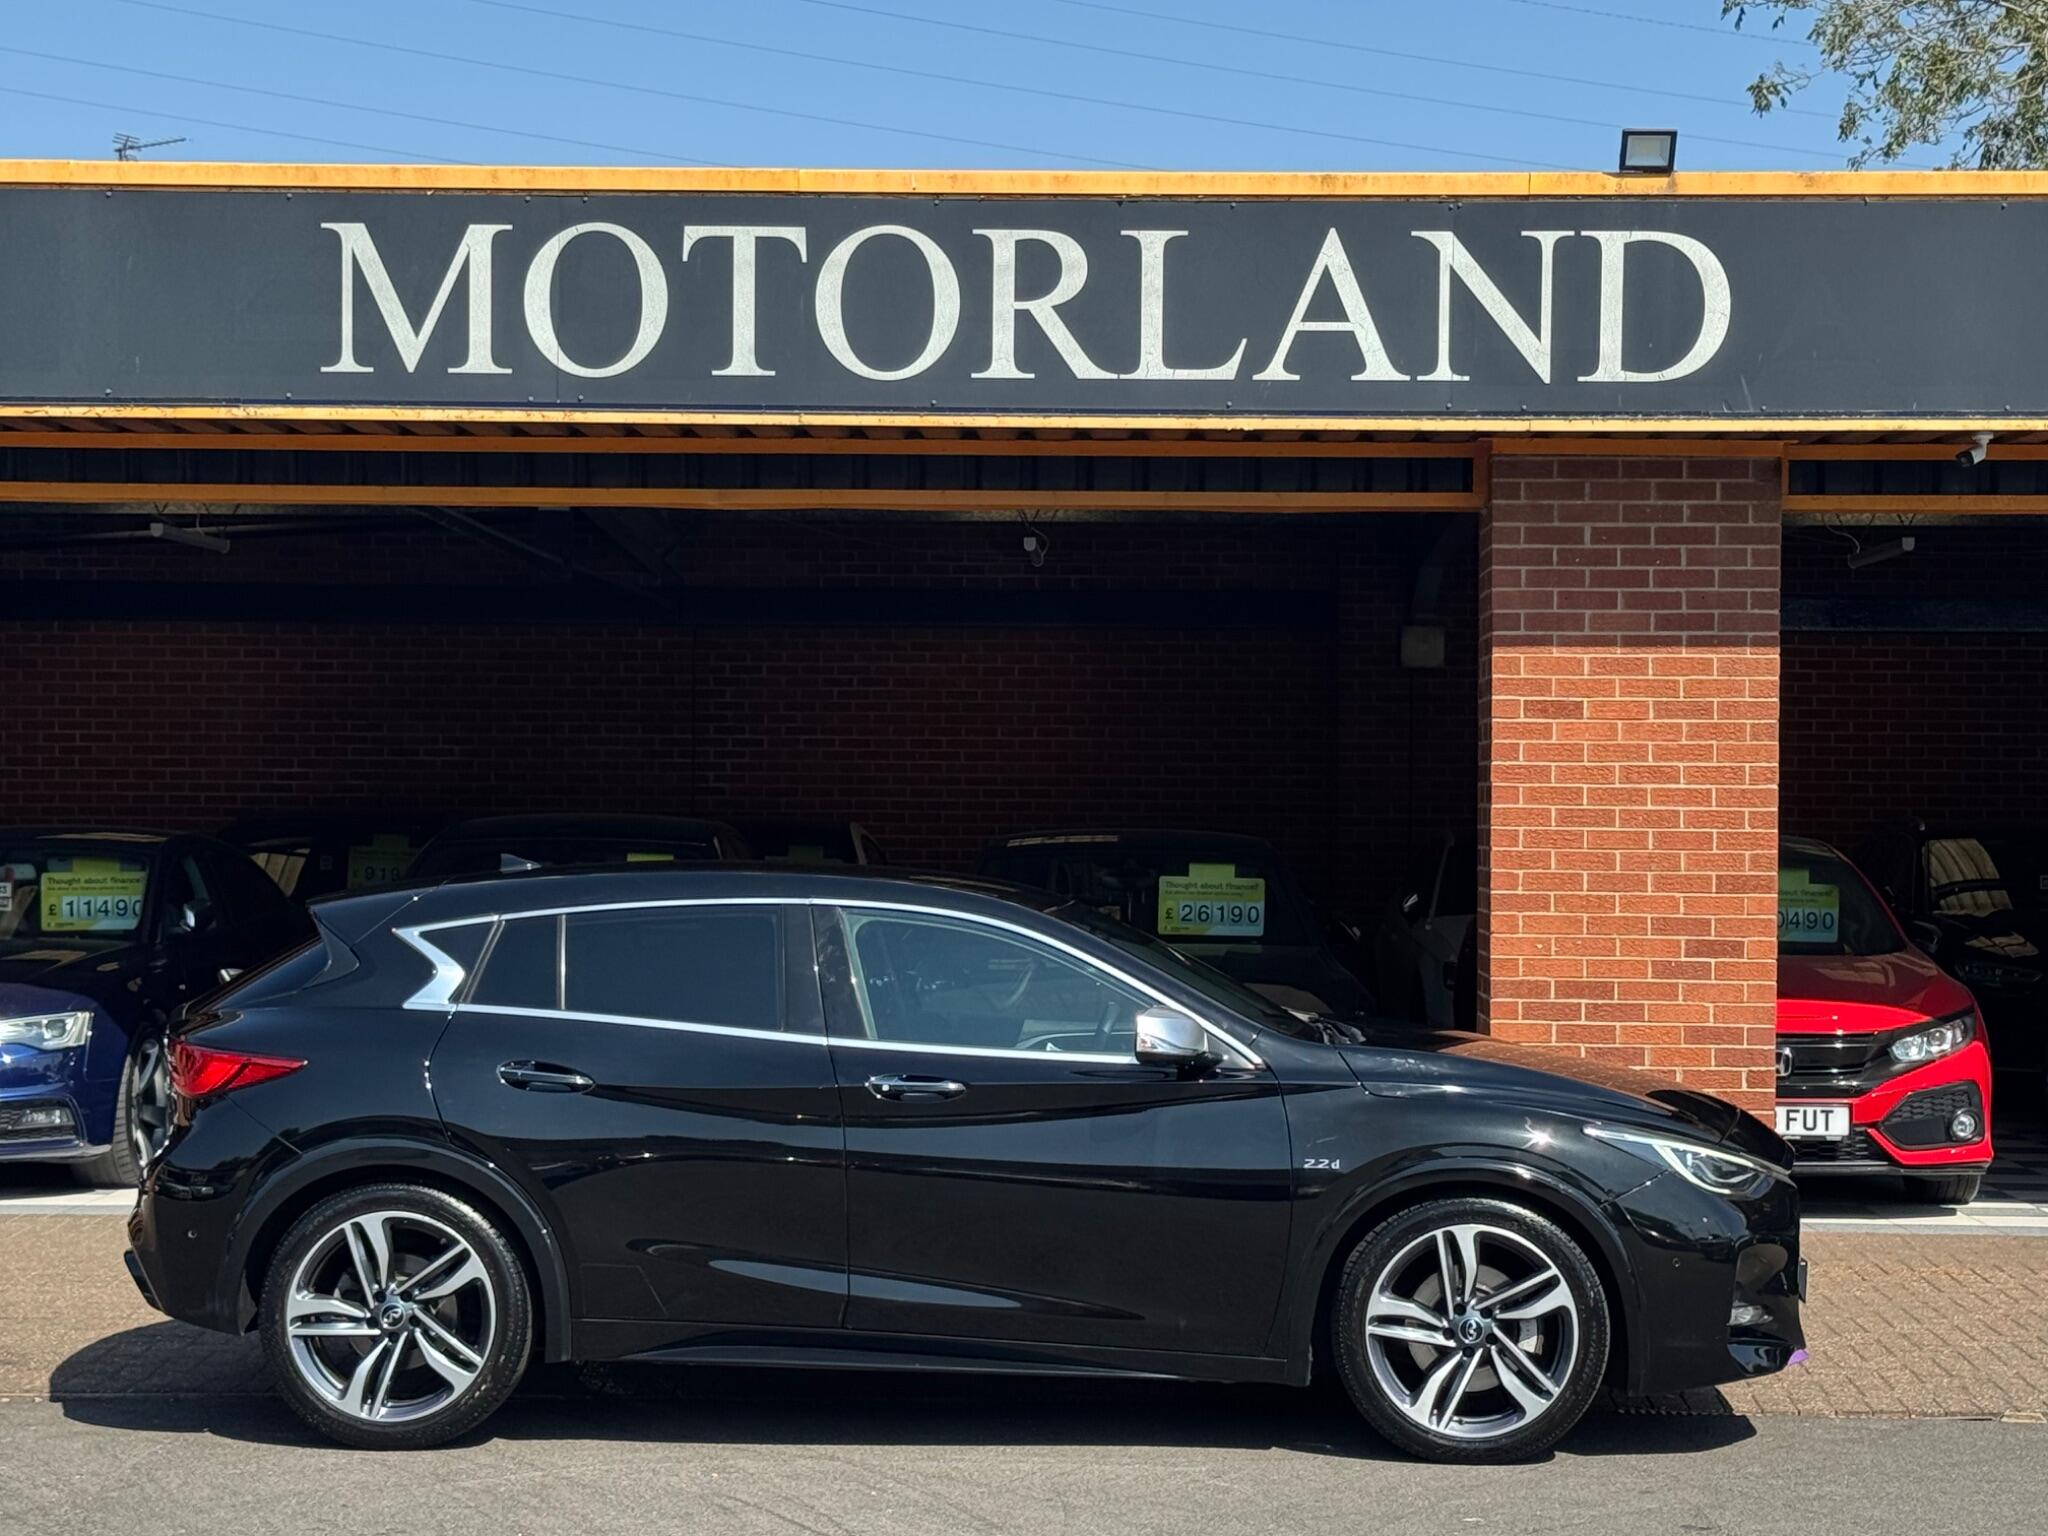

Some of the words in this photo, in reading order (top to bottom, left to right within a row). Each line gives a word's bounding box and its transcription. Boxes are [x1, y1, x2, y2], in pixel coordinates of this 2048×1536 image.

[321, 222, 1731, 383] MOTORLAND
[47, 877, 81, 886] Thought
[83, 877, 108, 885] about
[1165, 881, 1198, 890] Thought
[1200, 881, 1224, 890] about
[48, 903, 57, 916] £
[1165, 907, 1174, 920] £
[1181, 904, 1260, 923] 26190
[1786, 1109, 1834, 1131] FUT
